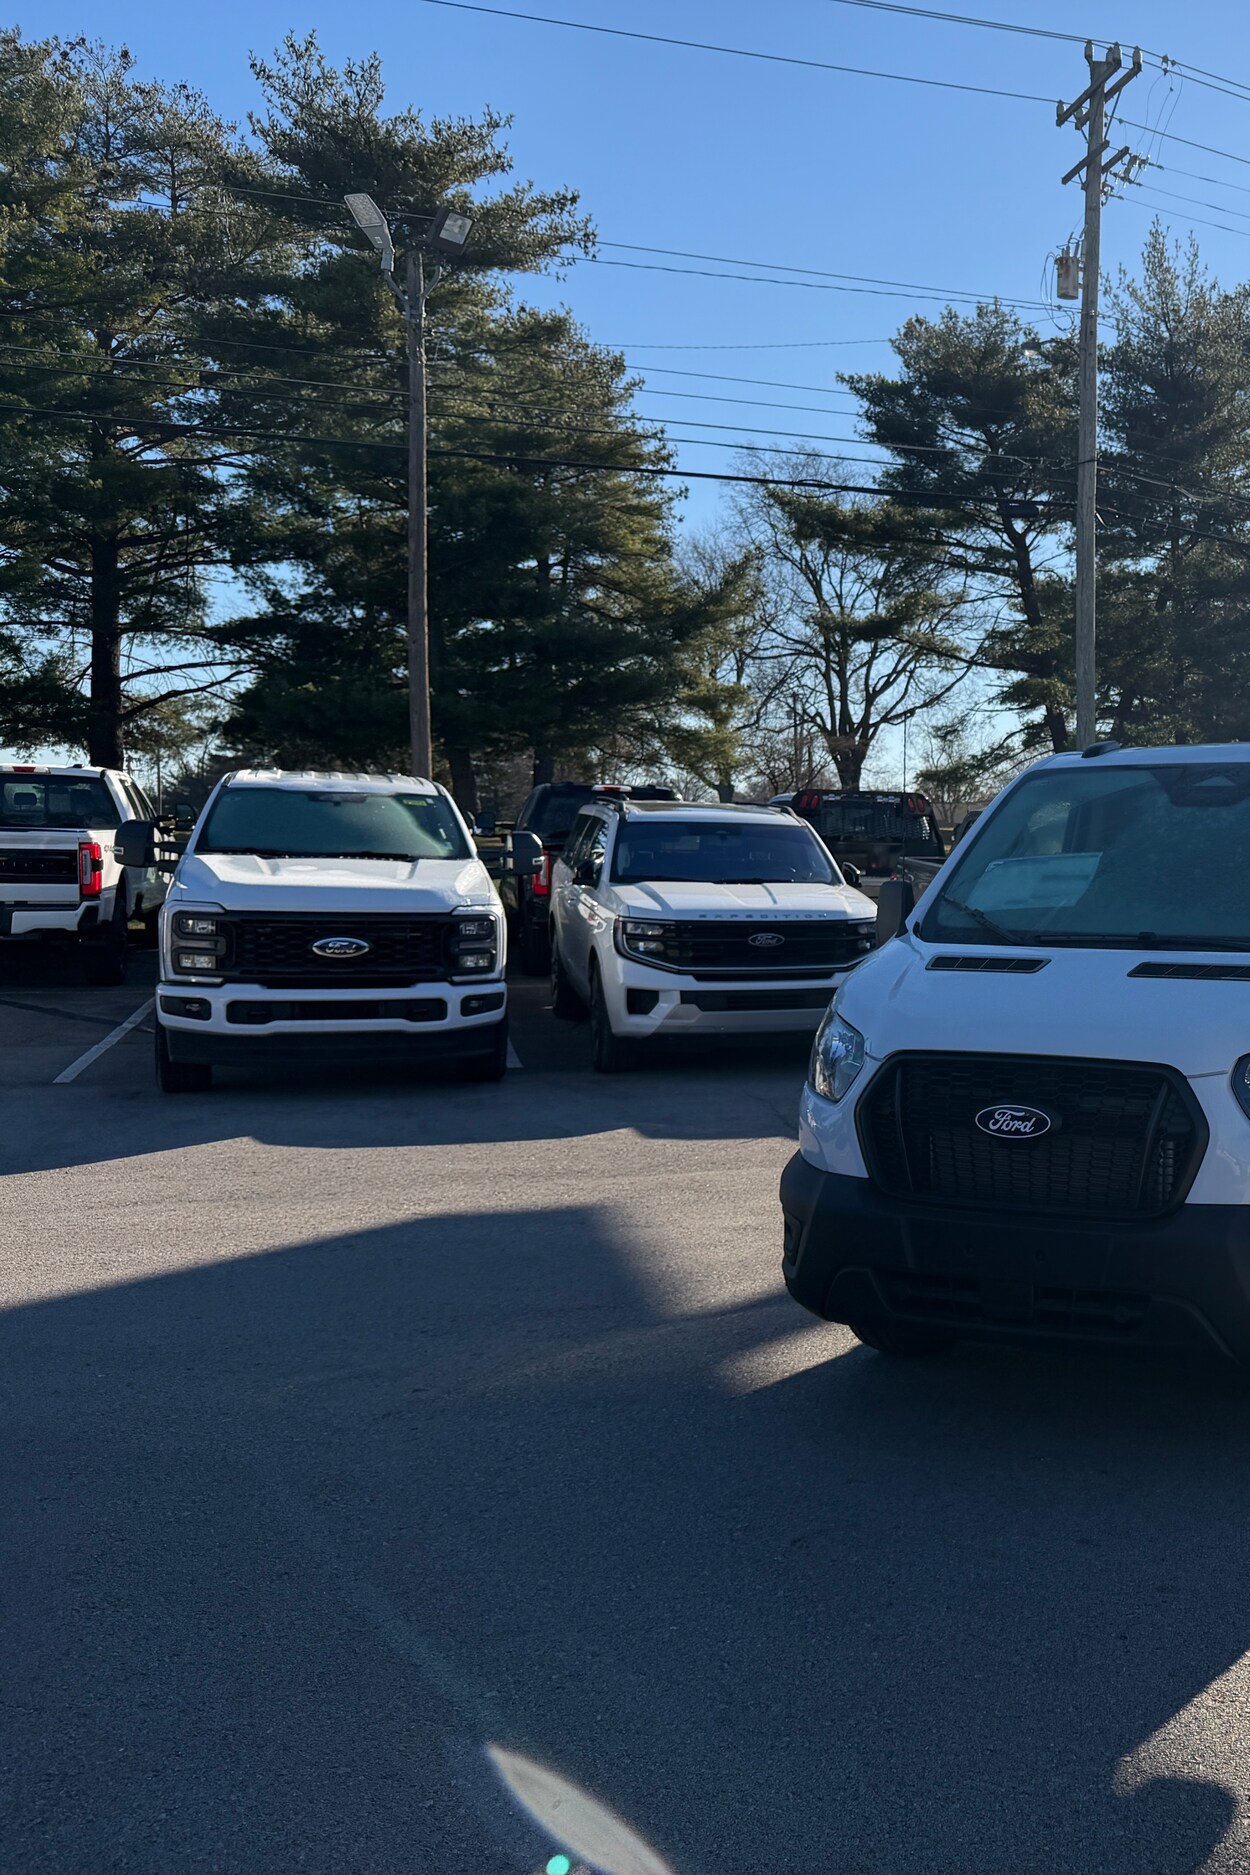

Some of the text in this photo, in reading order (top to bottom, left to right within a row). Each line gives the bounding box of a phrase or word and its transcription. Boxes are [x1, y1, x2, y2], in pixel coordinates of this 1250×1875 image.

[755, 935, 778, 945] Ford
[325, 941, 357, 953] Ford
[989, 1109, 1037, 1133] Ford
